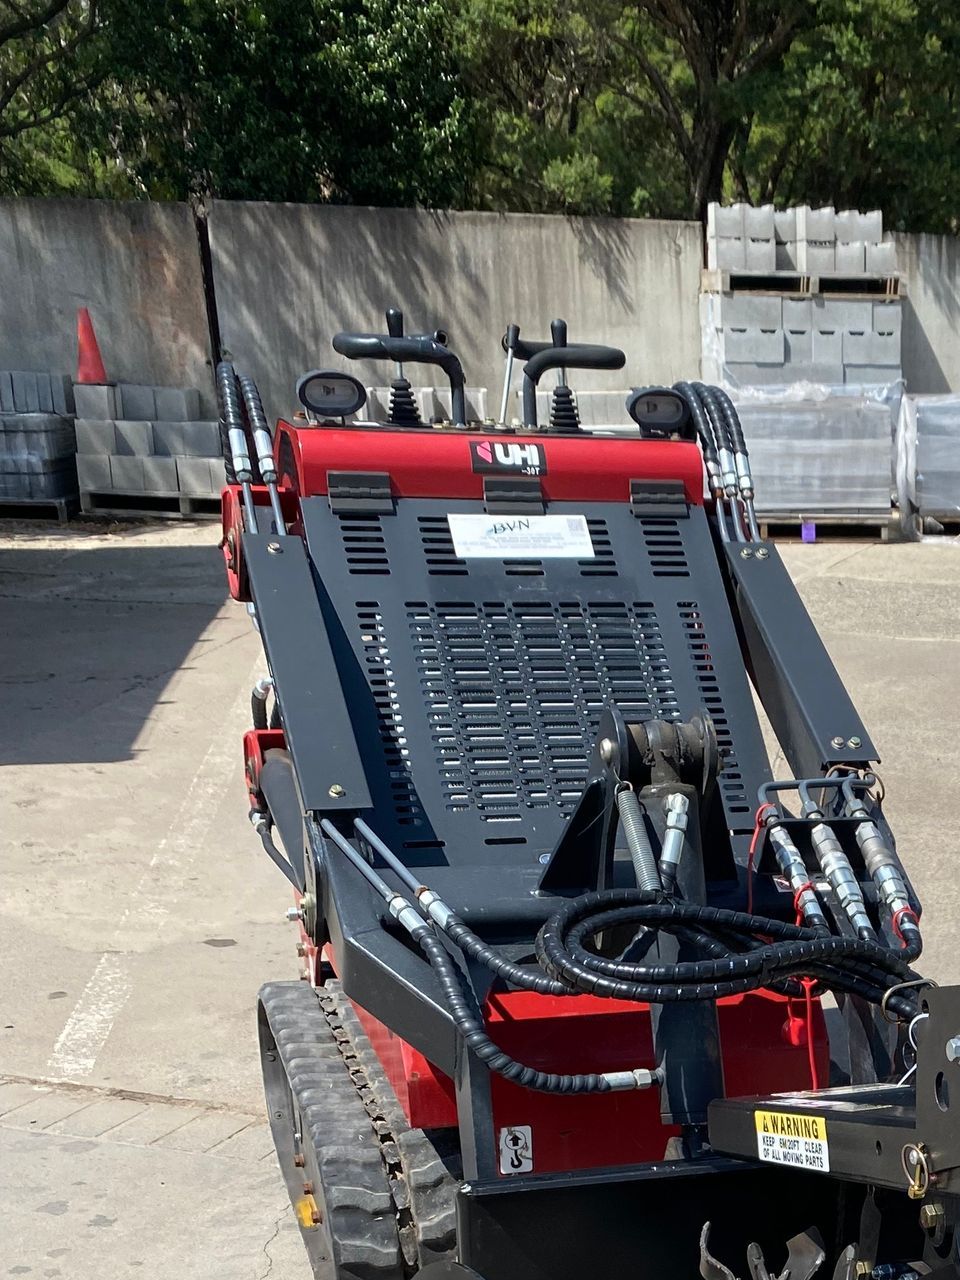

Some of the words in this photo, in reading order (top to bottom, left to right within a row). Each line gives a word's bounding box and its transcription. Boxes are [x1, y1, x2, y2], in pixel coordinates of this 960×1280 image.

[494, 442, 540, 466] UHI
[770, 1115, 819, 1139] WARNING
[763, 1136, 775, 1147] KEEP
[805, 1142, 823, 1154] CLEAR
[763, 1147, 770, 1159] OF
[772, 1149, 781, 1161] ALL
[782, 1151, 804, 1165] MOVING
[806, 1155, 824, 1168] PARTS
